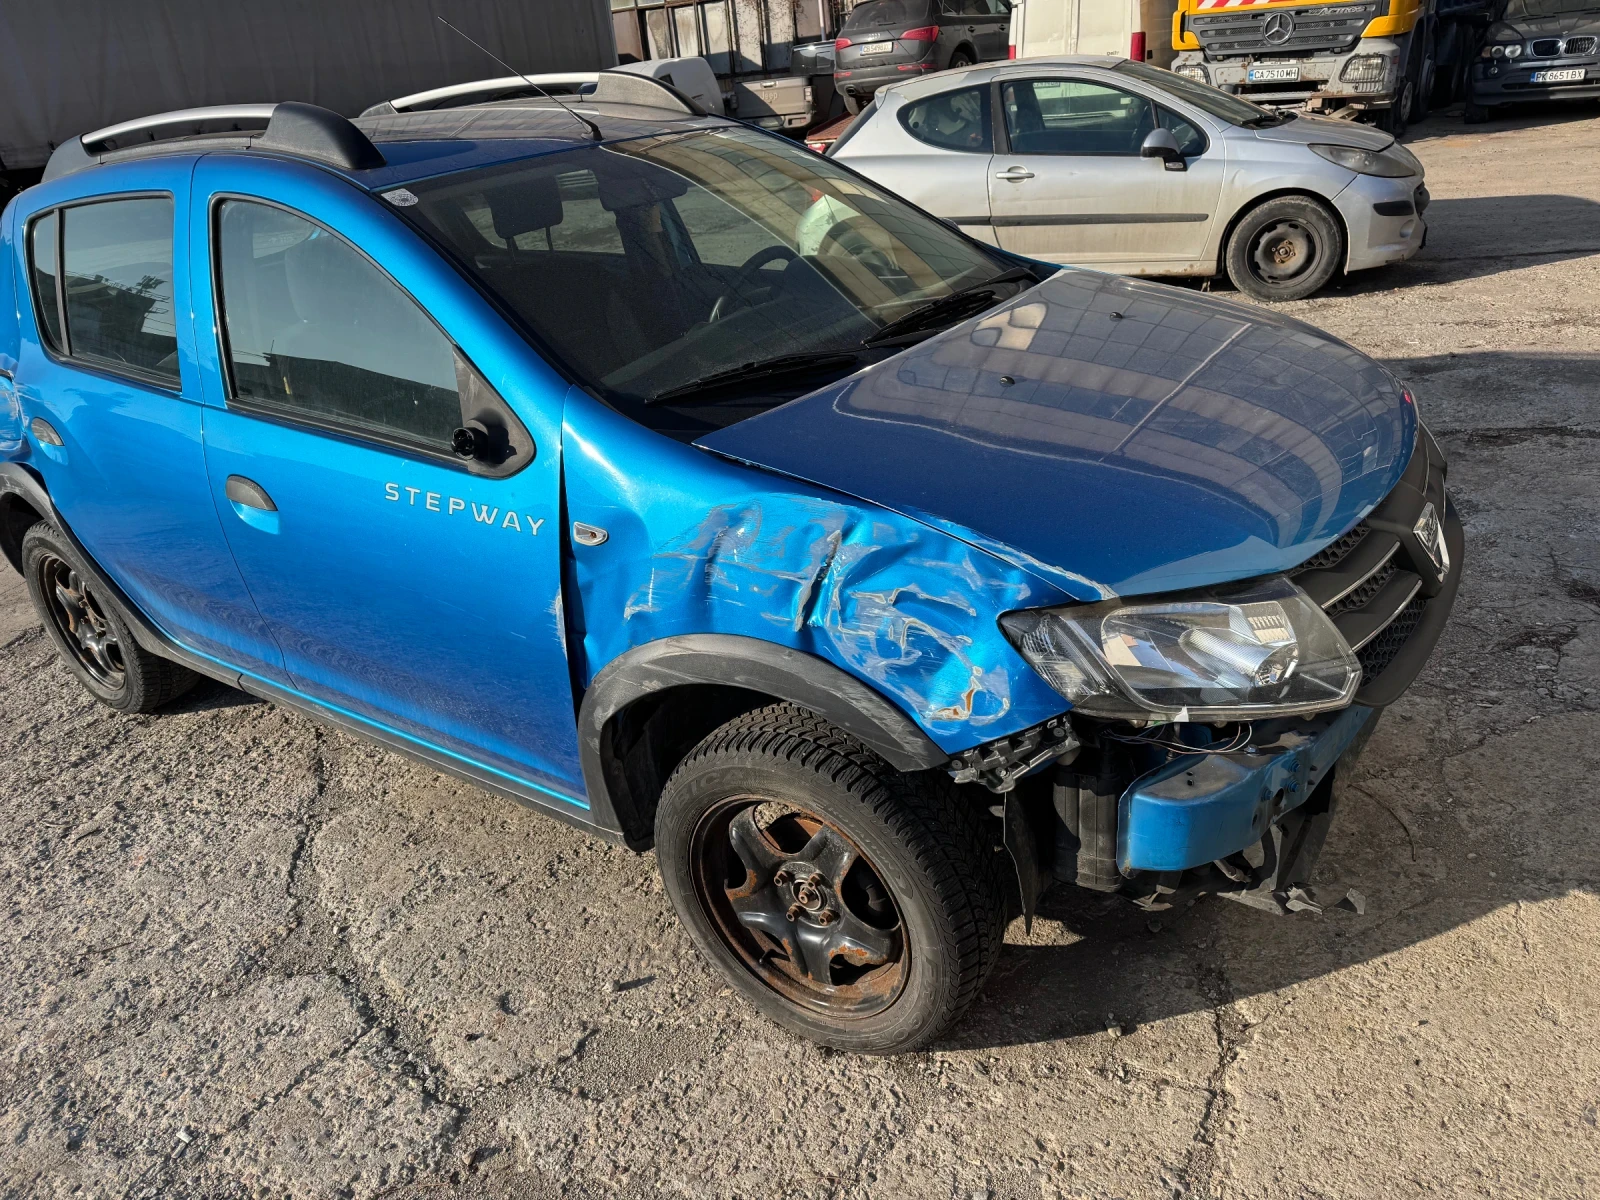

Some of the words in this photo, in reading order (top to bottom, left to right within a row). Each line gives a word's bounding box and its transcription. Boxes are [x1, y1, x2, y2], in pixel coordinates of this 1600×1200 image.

[1254, 70, 1265, 79] CA
[1265, 69, 1285, 78] 7510
[1535, 72, 1548, 82] PK
[1548, 71, 1570, 80] 8651
[1570, 70, 1583, 79] BX
[762, 91, 778, 100] Jeep
[385, 482, 546, 536] STEPWAY
